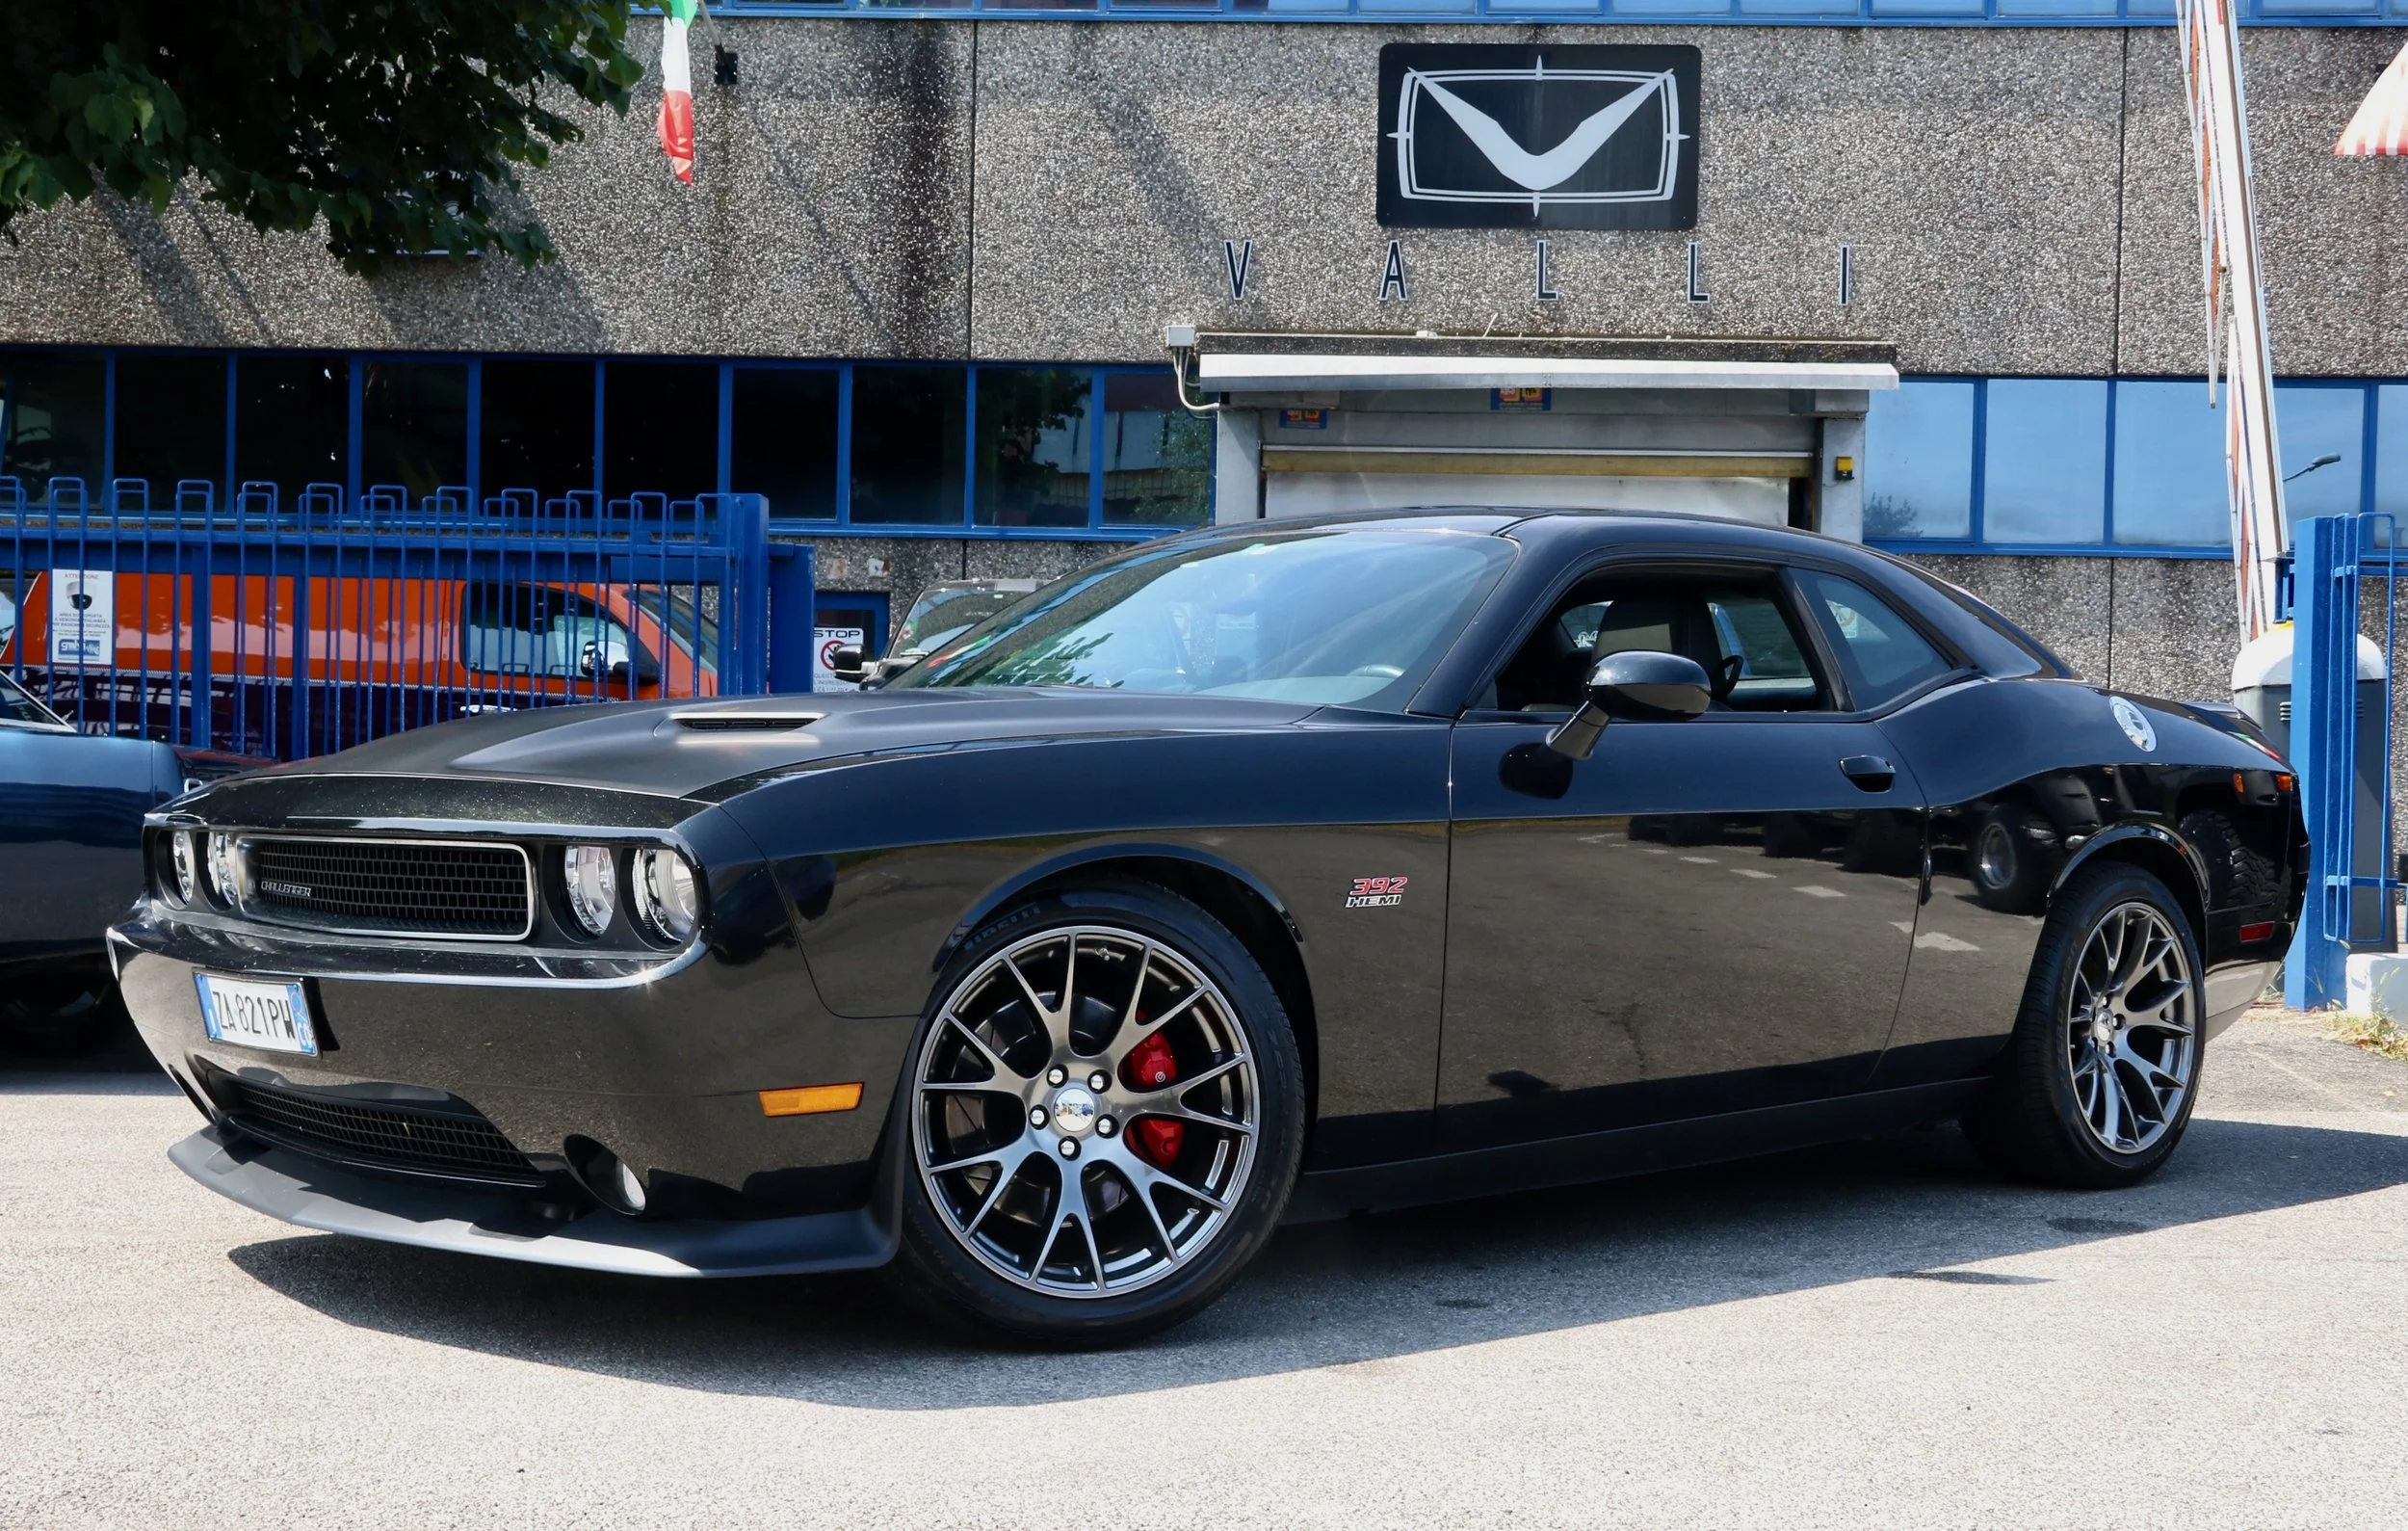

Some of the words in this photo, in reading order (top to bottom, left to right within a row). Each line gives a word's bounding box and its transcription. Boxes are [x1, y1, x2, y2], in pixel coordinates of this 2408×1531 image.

[1223, 239, 1849, 305] VALLI
[814, 629, 860, 638] STOP
[1349, 876, 1408, 895] 392
[1345, 894, 1401, 908] HEMI
